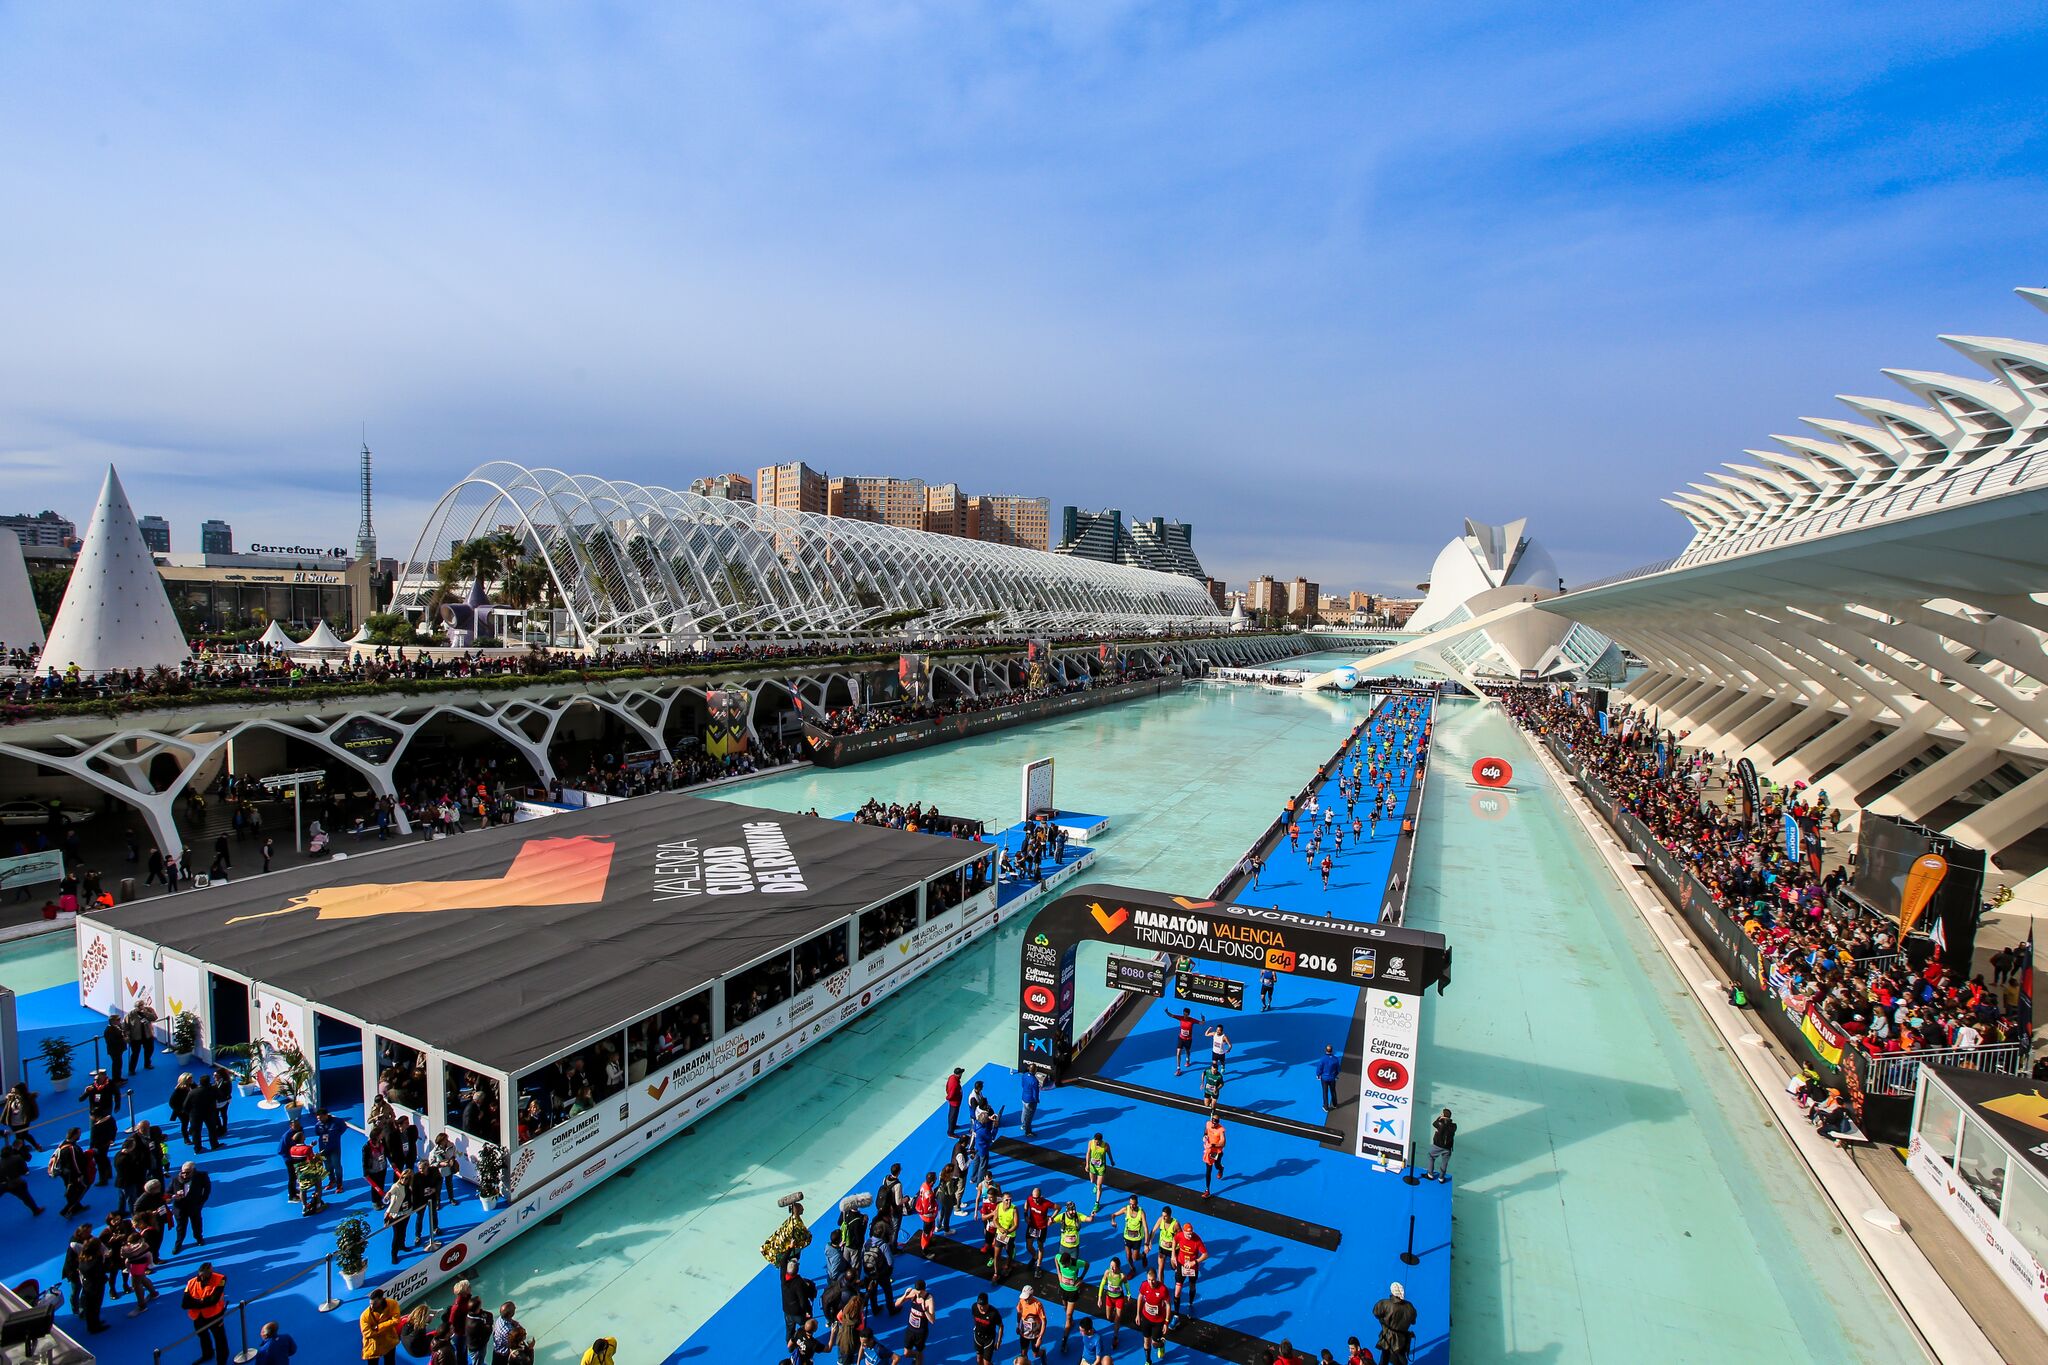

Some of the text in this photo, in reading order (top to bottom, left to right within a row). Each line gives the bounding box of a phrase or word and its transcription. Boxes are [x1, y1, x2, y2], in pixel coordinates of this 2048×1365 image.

[251, 543, 323, 555] Carrefour
[293, 572, 305, 582] El
[308, 573, 339, 583] Saler
[344, 738, 394, 749] ROBOTS
[1481, 766, 1500, 779] edp
[653, 838, 702, 902] VALENCIA
[703, 846, 755, 895] CIUDAD
[1226, 905, 1386, 937] @VCRunning
[1134, 910, 1285, 947] MARATÓN VALENCIA
[1027, 944, 1056, 956] TRINIDAD
[1134, 926, 1338, 973] TRINIDAD ALFONSO edp 2016
[1027, 951, 1056, 962] ALFONSO
[1026, 967, 1049, 976] Cultura
[1121, 966, 1144, 979] 6080
[1386, 968, 1406, 977] AIMS
[1025, 973, 1055, 985] Esfuerzo
[1194, 977, 1224, 989] 3:41:33
[1031, 993, 1046, 1005] edp
[1022, 1012, 1055, 1025] BROOKS
[1374, 1008, 1412, 1021] TRINIDAD
[1373, 1015, 1412, 1029] ALFONSO
[1811, 1013, 1836, 1046] BOLIVIA
[1372, 1037, 1402, 1050] Cultura
[672, 1033, 744, 1080] MARATÓN VALENCIA
[1370, 1045, 1409, 1059] Esfuerzo
[672, 1068, 705, 1091] TRINIDAD
[705, 1047, 736, 1070] ALFONSO
[750, 1031, 766, 1046] 2016
[1377, 1068, 1397, 1082] edp
[1364, 1089, 1409, 1104] BROOKS
[552, 1113, 600, 1146] COMPLIMENTI
[1363, 1142, 1402, 1155] POWERADE
[477, 1216, 508, 1240] BROOKS
[446, 1251, 460, 1264] edp
[382, 1272, 418, 1299] ultura
